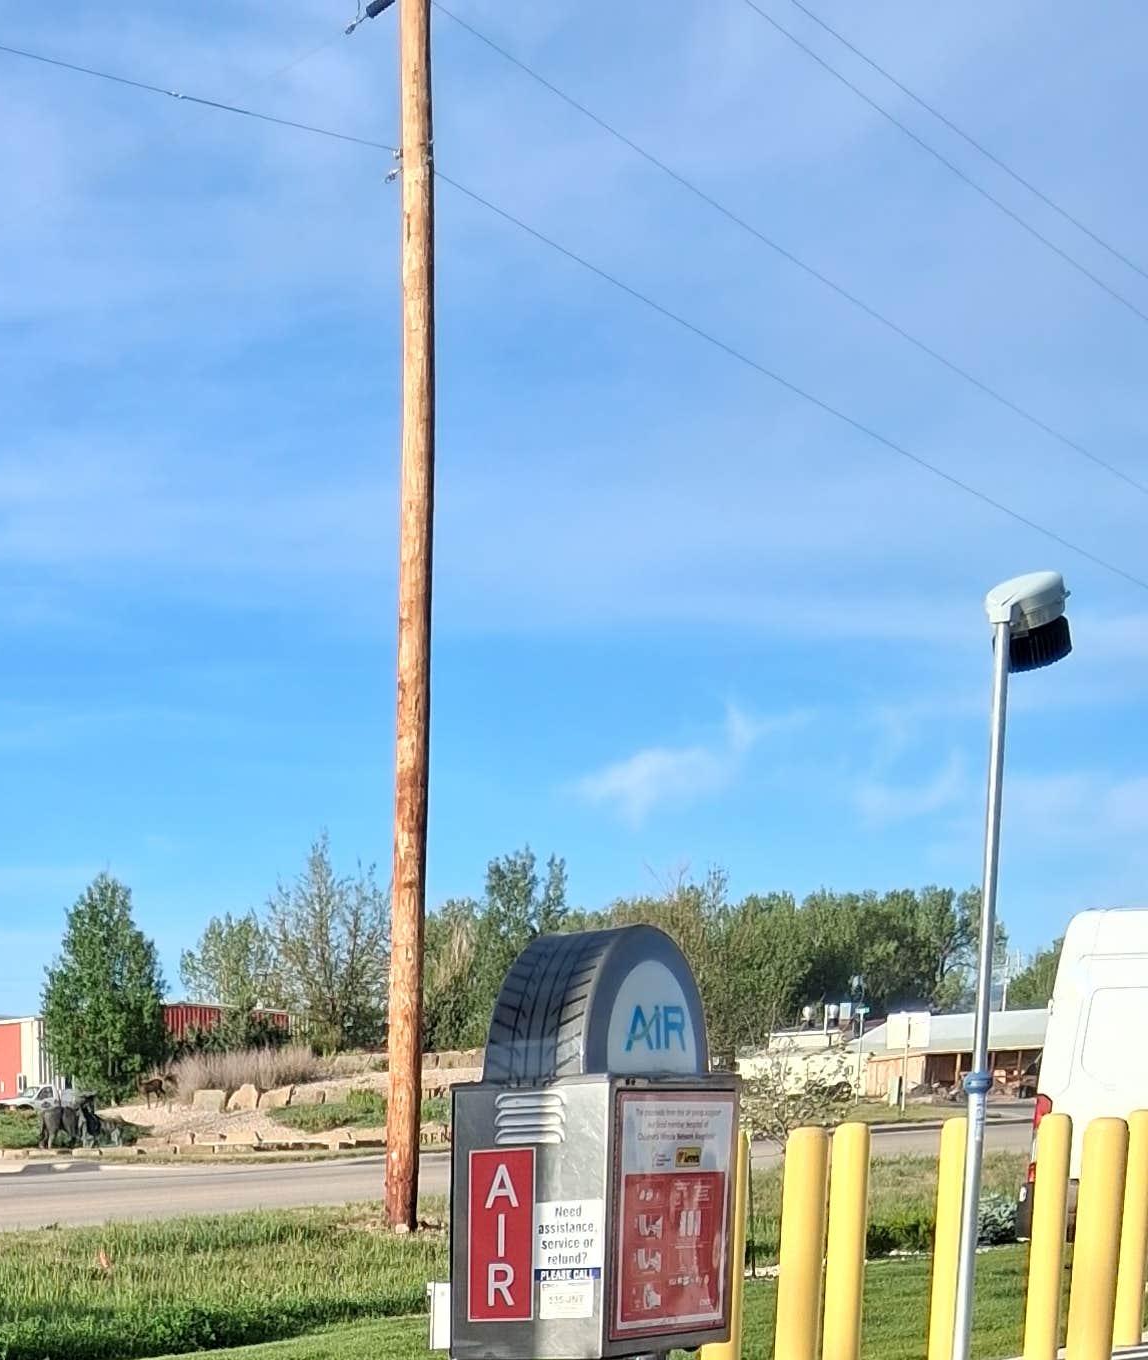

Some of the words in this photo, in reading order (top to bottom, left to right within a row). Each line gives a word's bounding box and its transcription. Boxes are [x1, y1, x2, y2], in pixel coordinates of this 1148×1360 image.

[555, 1205, 582, 1217] Need
[541, 1238, 579, 1250] service
[583, 1238, 594, 1248] or
[548, 1252, 588, 1265] refund?
[540, 1269, 572, 1281] PLEASE
[573, 1269, 595, 1280] CALL
